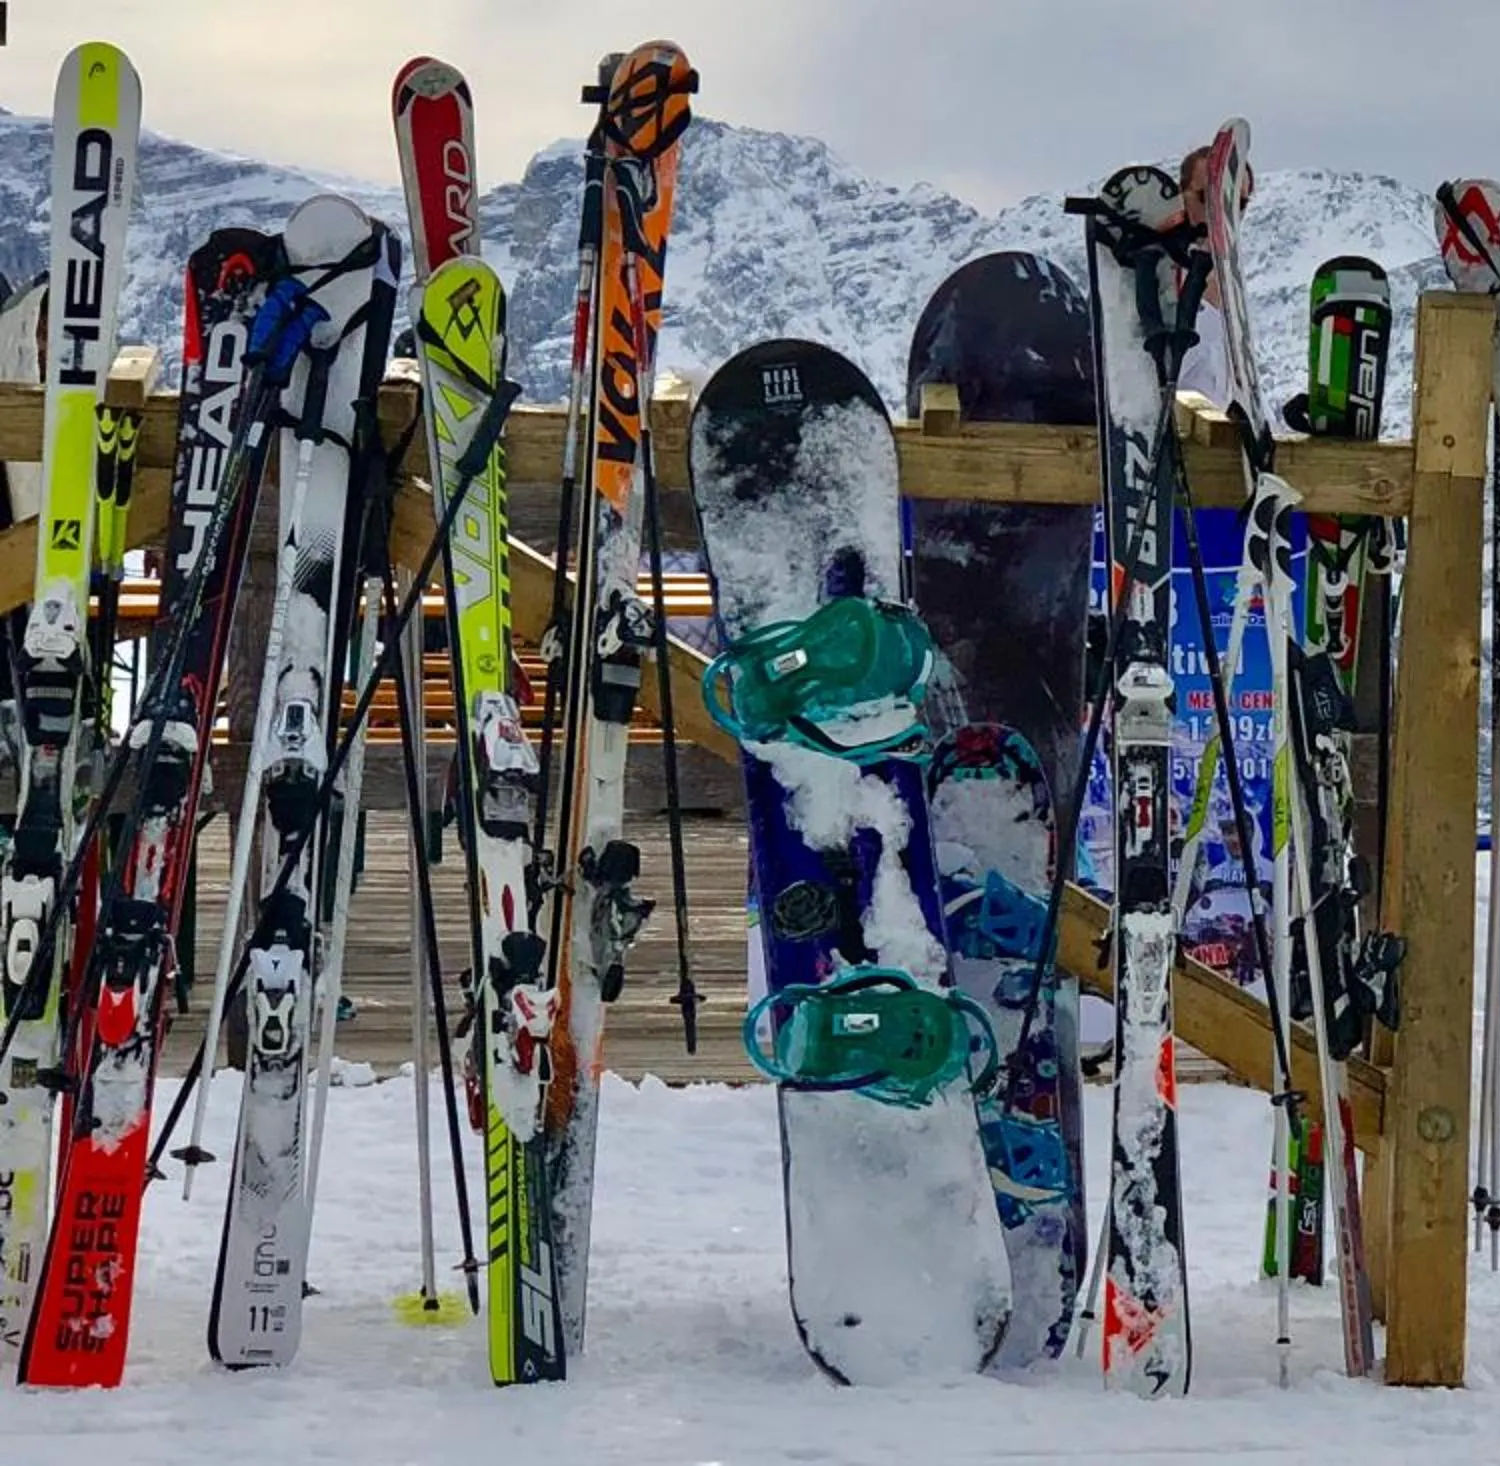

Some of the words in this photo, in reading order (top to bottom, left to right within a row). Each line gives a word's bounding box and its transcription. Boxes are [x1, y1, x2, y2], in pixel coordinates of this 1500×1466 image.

[59, 127, 112, 385] HEAD
[175, 319, 248, 579] HEAD
[54, 1191, 99, 1352] SUPER
[249, 1305, 269, 1332] 11
[519, 1240, 556, 1357] SL
